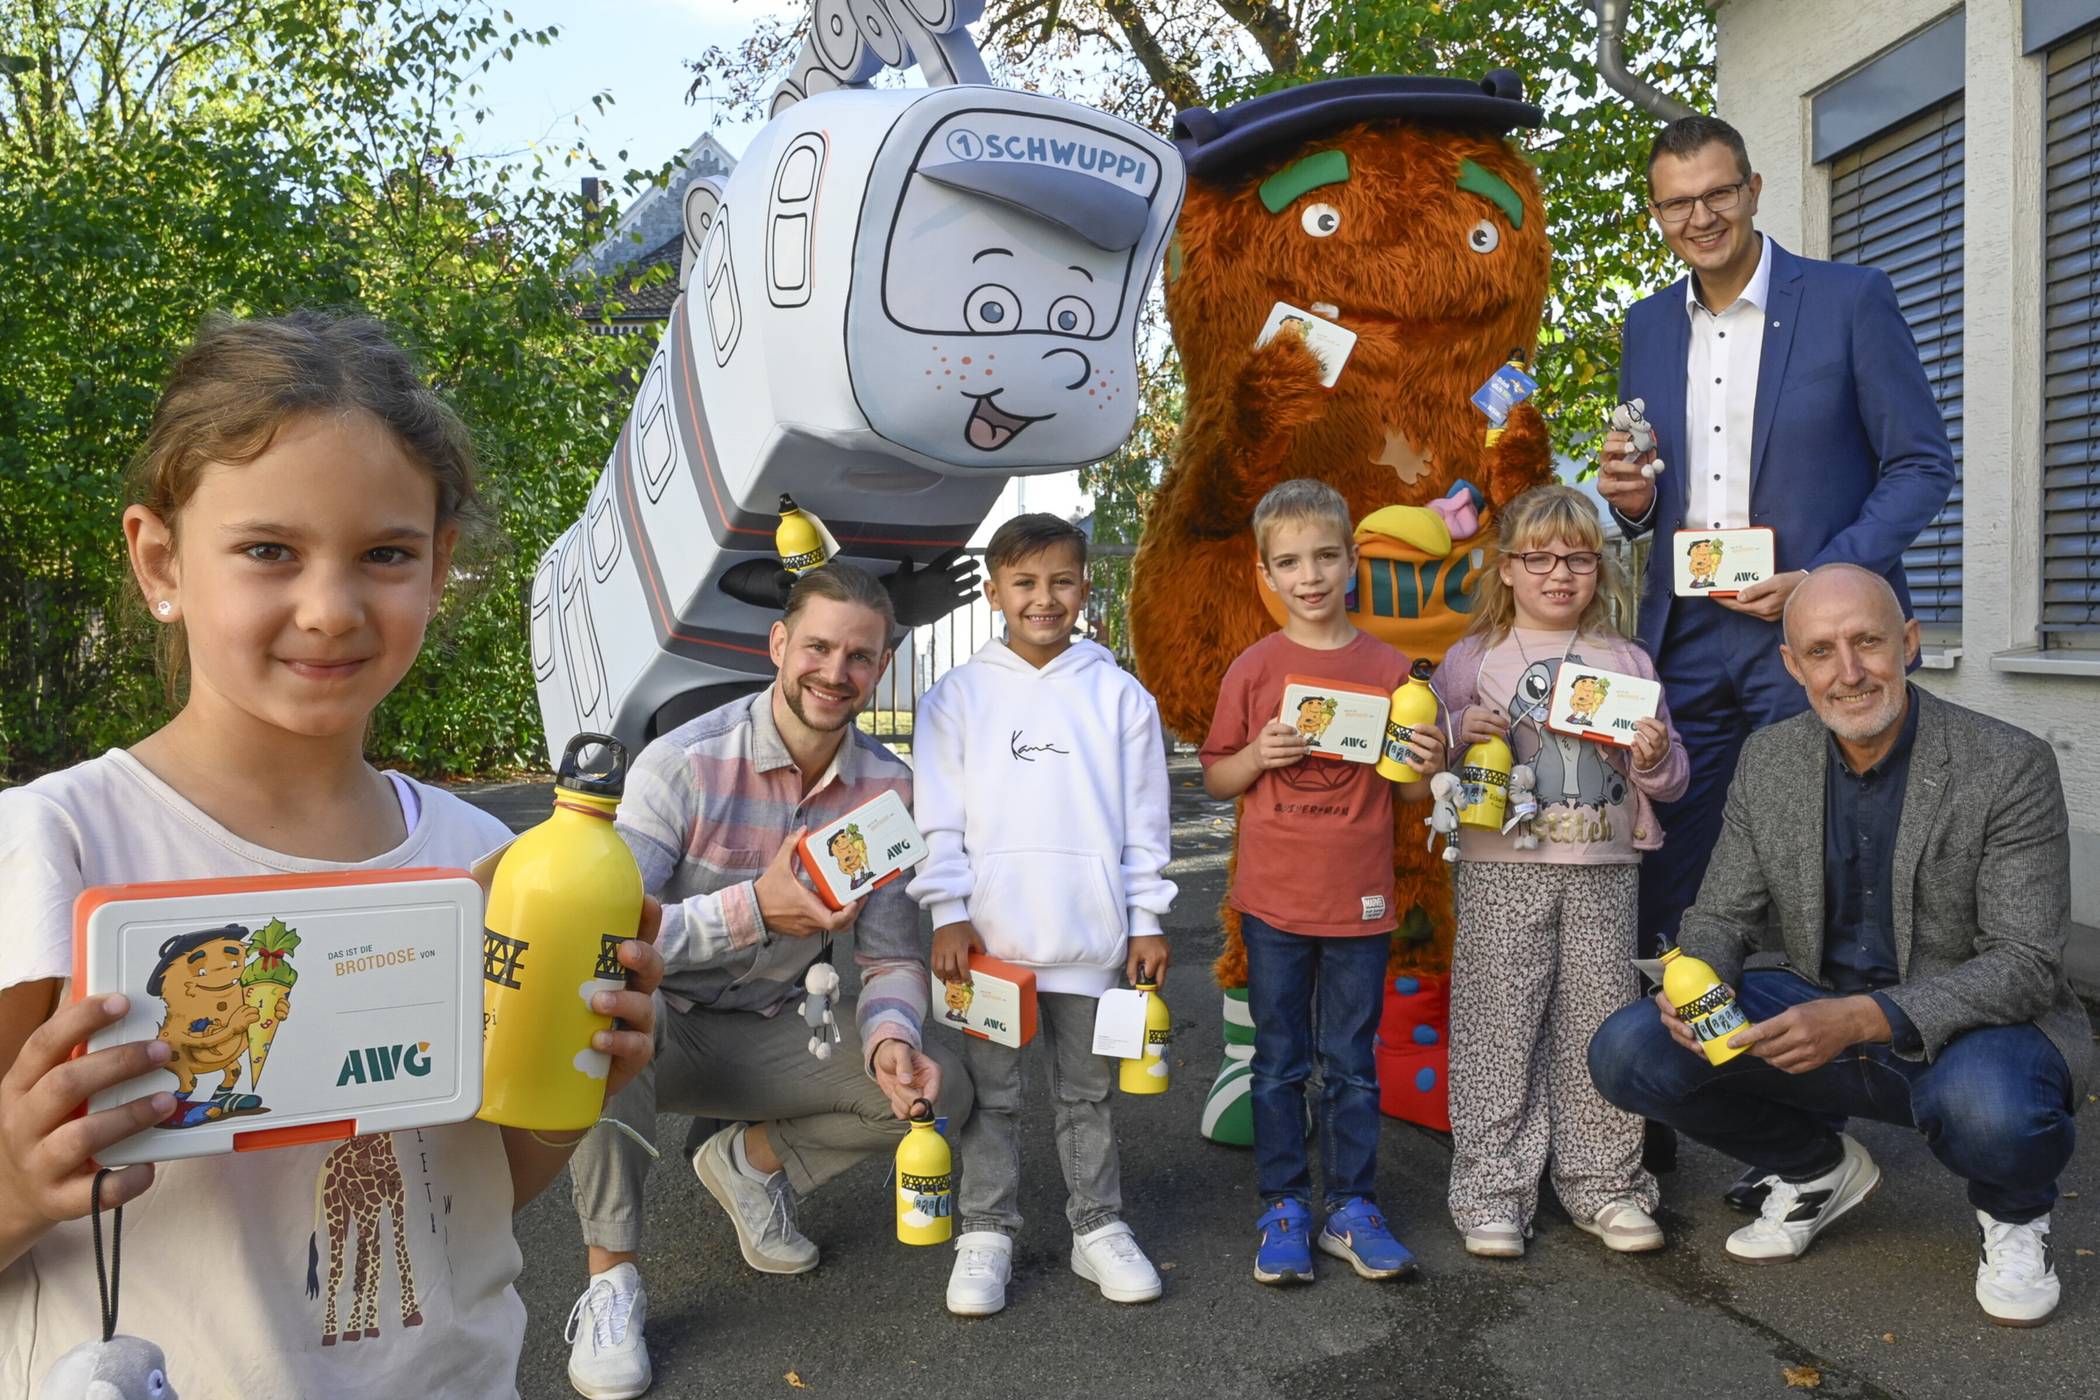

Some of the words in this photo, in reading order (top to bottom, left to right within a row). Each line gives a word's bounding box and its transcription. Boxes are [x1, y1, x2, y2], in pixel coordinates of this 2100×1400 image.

[956, 134, 972, 157] 1
[985, 133, 1148, 185] SCHWUPPI
[1345, 548, 1484, 618] WG
[1733, 571, 1760, 582] AWG
[1340, 736, 1368, 749] AWG
[886, 839, 911, 860] AWG
[328, 950, 344, 960] DAS
[345, 947, 358, 957] IST
[360, 944, 373, 954] DIE
[335, 947, 416, 977] BROTDOSE
[420, 949, 436, 959] VON
[983, 1017, 1007, 1032] AWG
[336, 1041, 431, 1087] AWG
